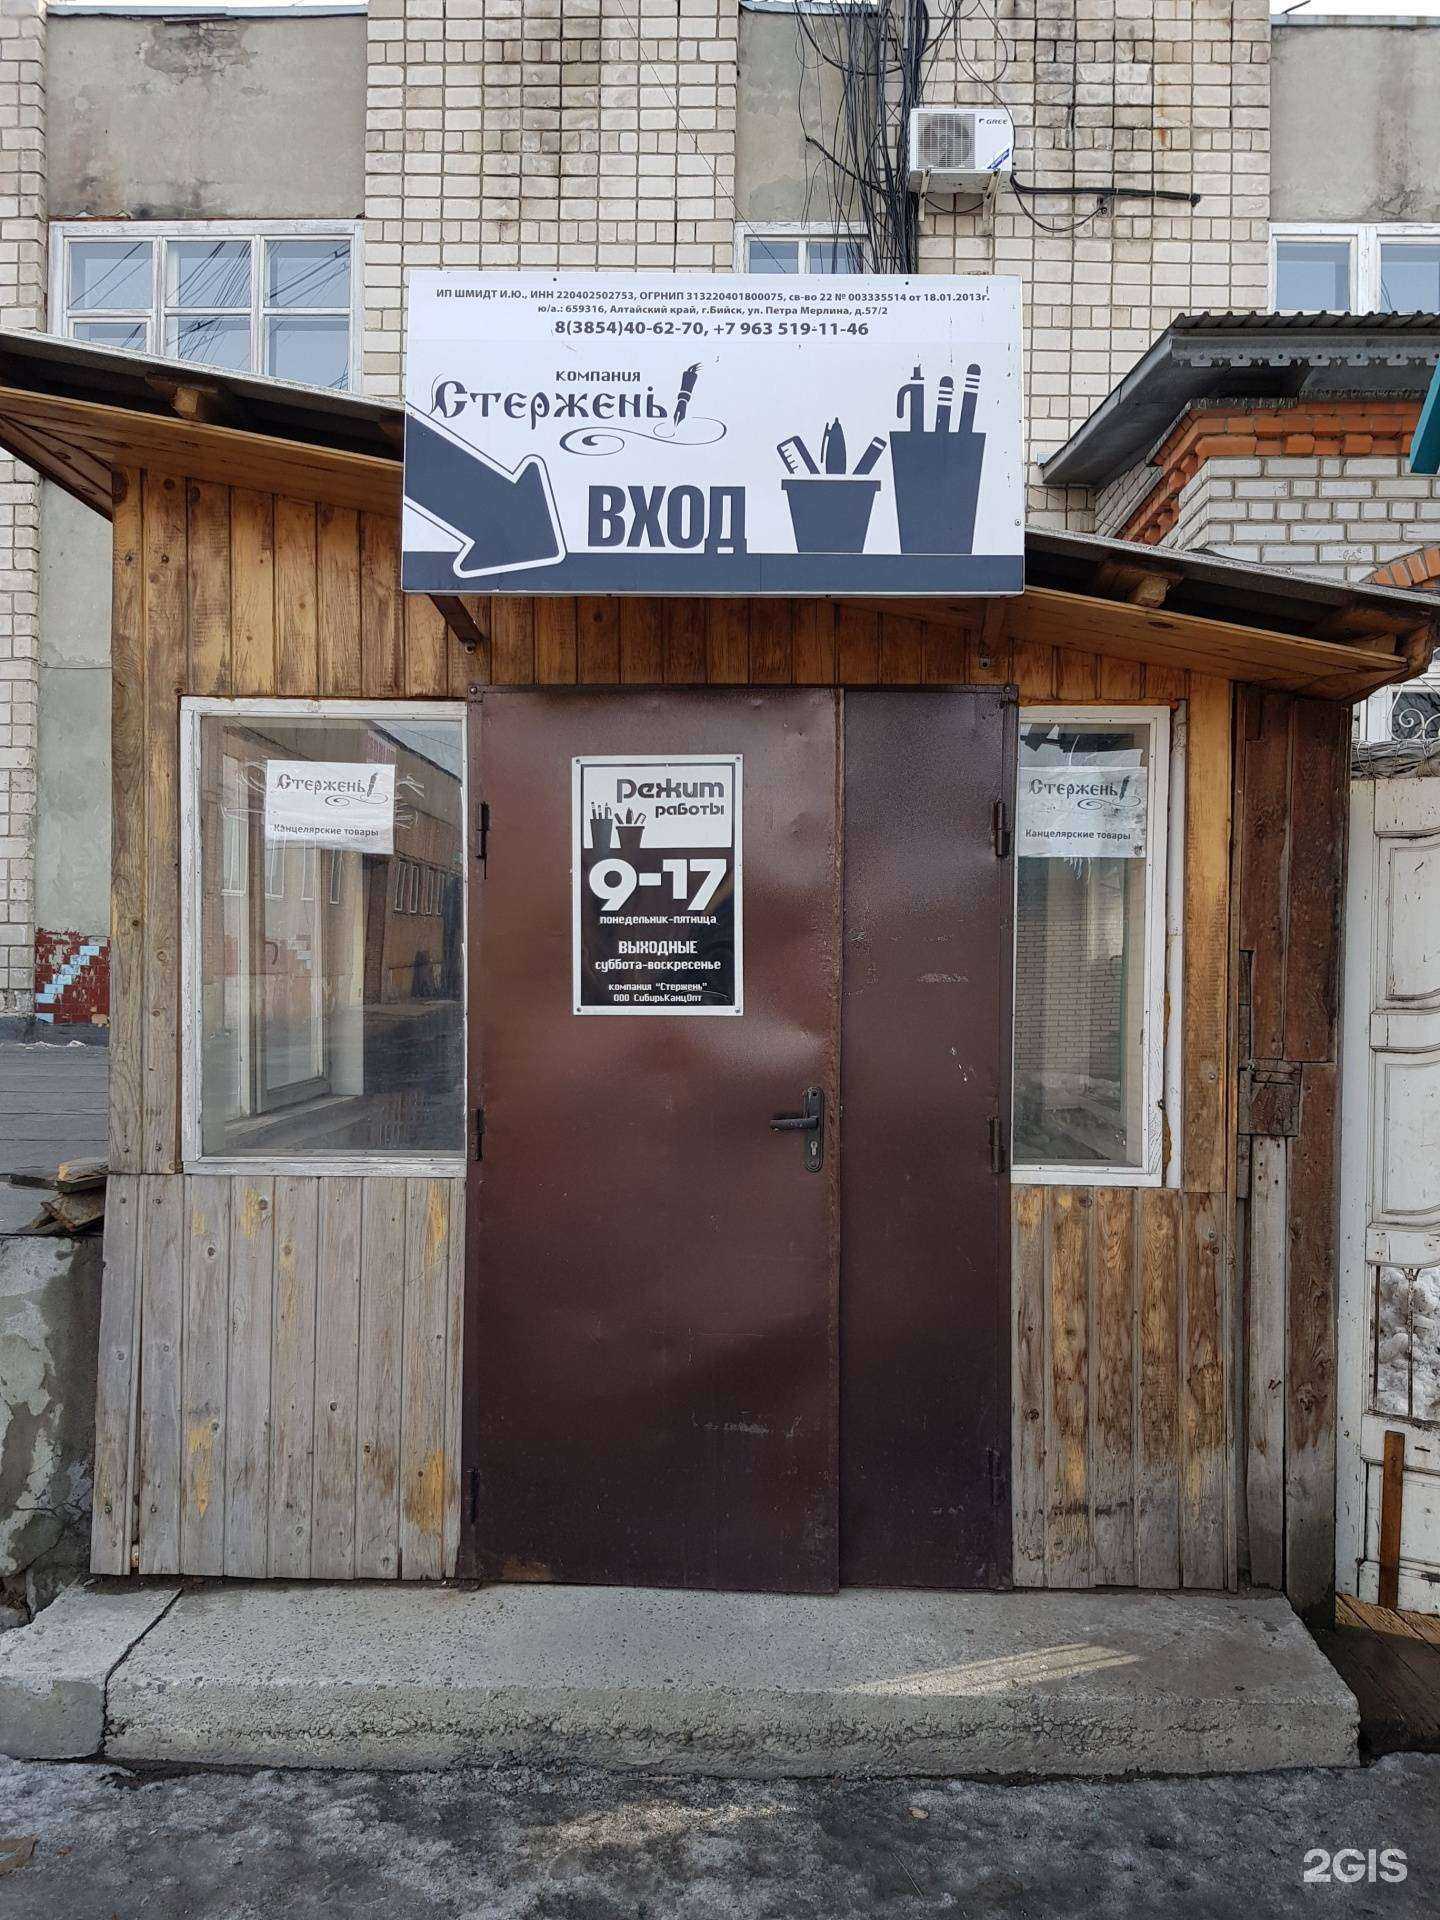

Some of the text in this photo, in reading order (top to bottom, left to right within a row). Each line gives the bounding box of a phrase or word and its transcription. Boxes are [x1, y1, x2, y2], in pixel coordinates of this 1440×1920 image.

[436, 289, 990, 302] ИП ШМИДТ И.Ю., ИНН 220402502753, ОГРНИП 313220401800075, св-во 22 № 003335514 от 18.01.2013г.
[538, 304, 889, 317] ю/а.: 659316, Алтайский край, г.Бийск, ул. Петра Мерлина, д.57/2
[554, 320, 870, 337] 8(3854)40-62-70, +7 963 519-11-46
[555, 369, 642, 383] компания
[587, 484, 748, 554] ВХОД
[616, 778, 725, 803] Режим
[655, 803, 725, 819] работы
[274, 824, 379, 838] Канцелярские товары
[1025, 829, 1131, 842] Канцелярские товары
[588, 858, 727, 911] 9-17
[600, 915, 718, 926] понедельник-пятница
[618, 940, 699, 956] ВЫХОДНЫЕ
[595, 958, 722, 973] суббота-воскресенье
[608, 983, 653, 992] компания
[613, 993, 703, 1003] ООО СибирьКанцОпт
